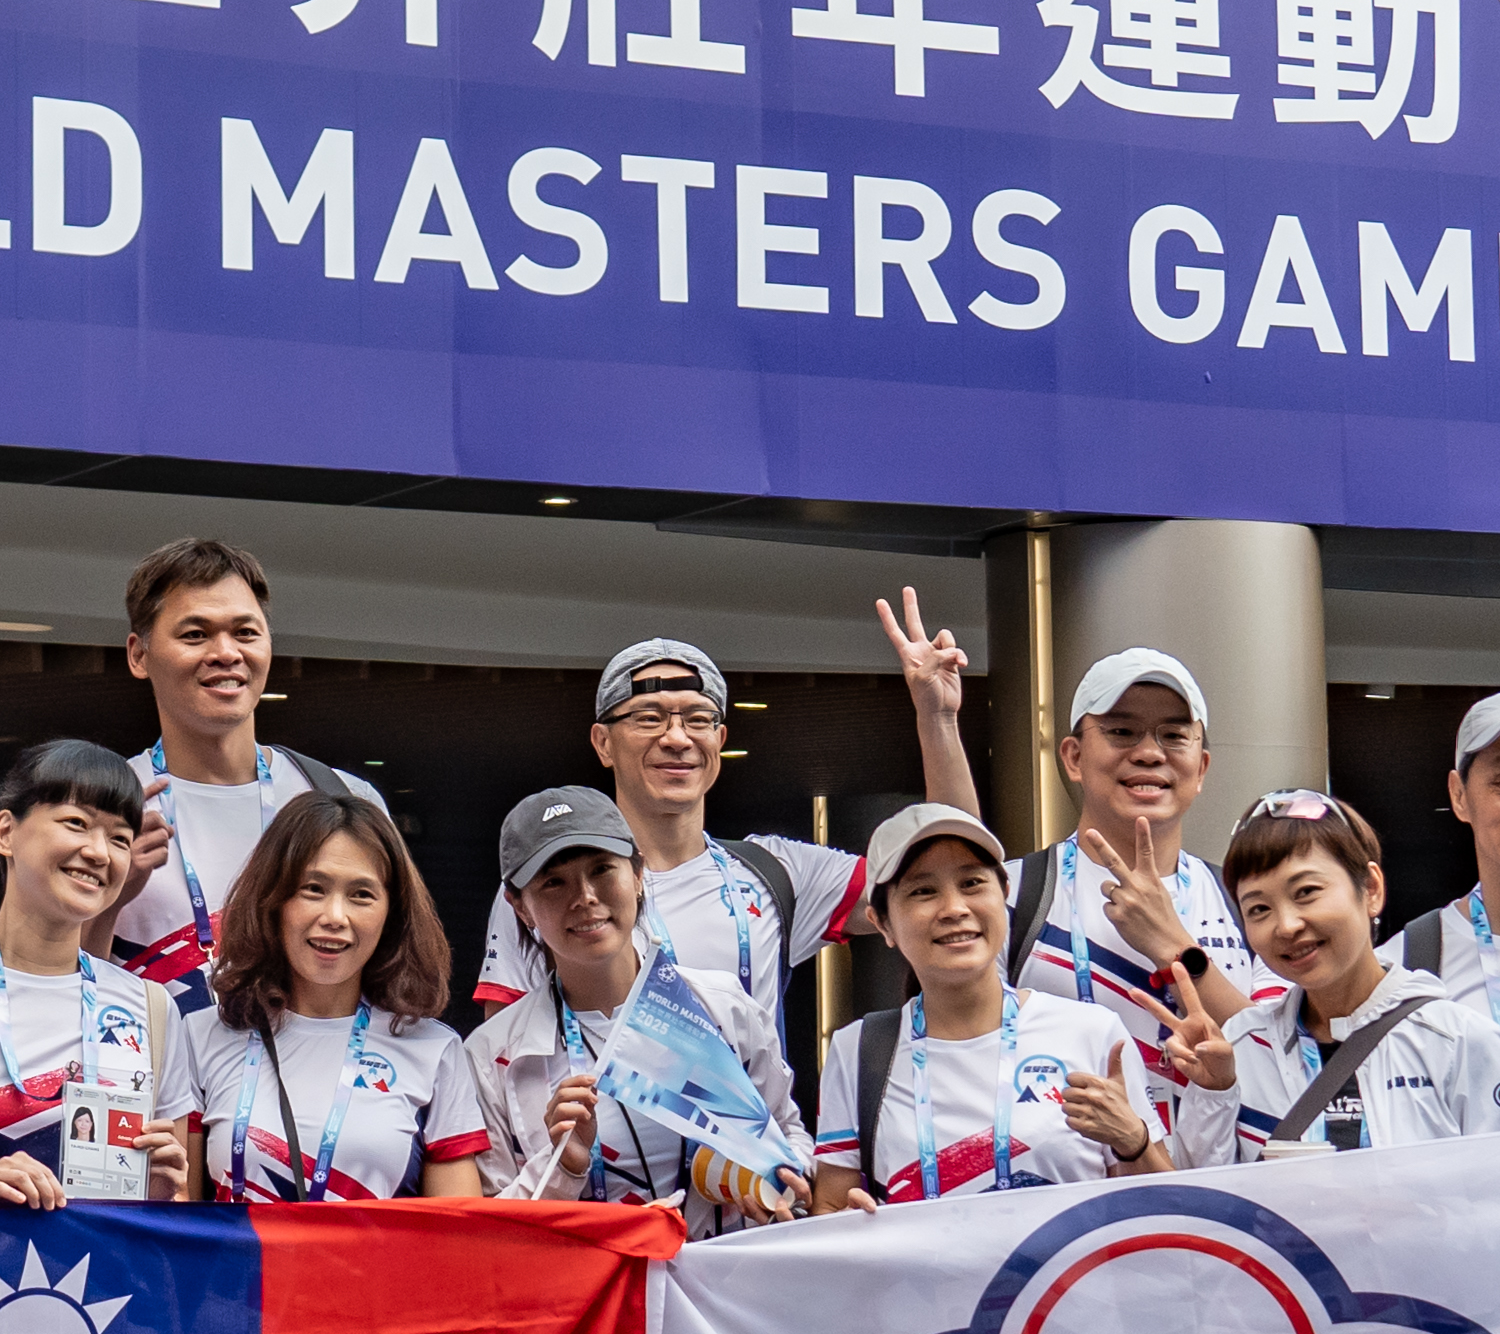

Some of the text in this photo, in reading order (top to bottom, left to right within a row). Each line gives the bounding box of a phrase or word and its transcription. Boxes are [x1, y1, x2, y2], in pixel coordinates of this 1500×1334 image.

[221, 117, 1066, 330] MASTERS
[635, 1010, 671, 1036] 2025
[647, 990, 680, 1013] WORLD
[680, 1006, 719, 1037] MASTERS
